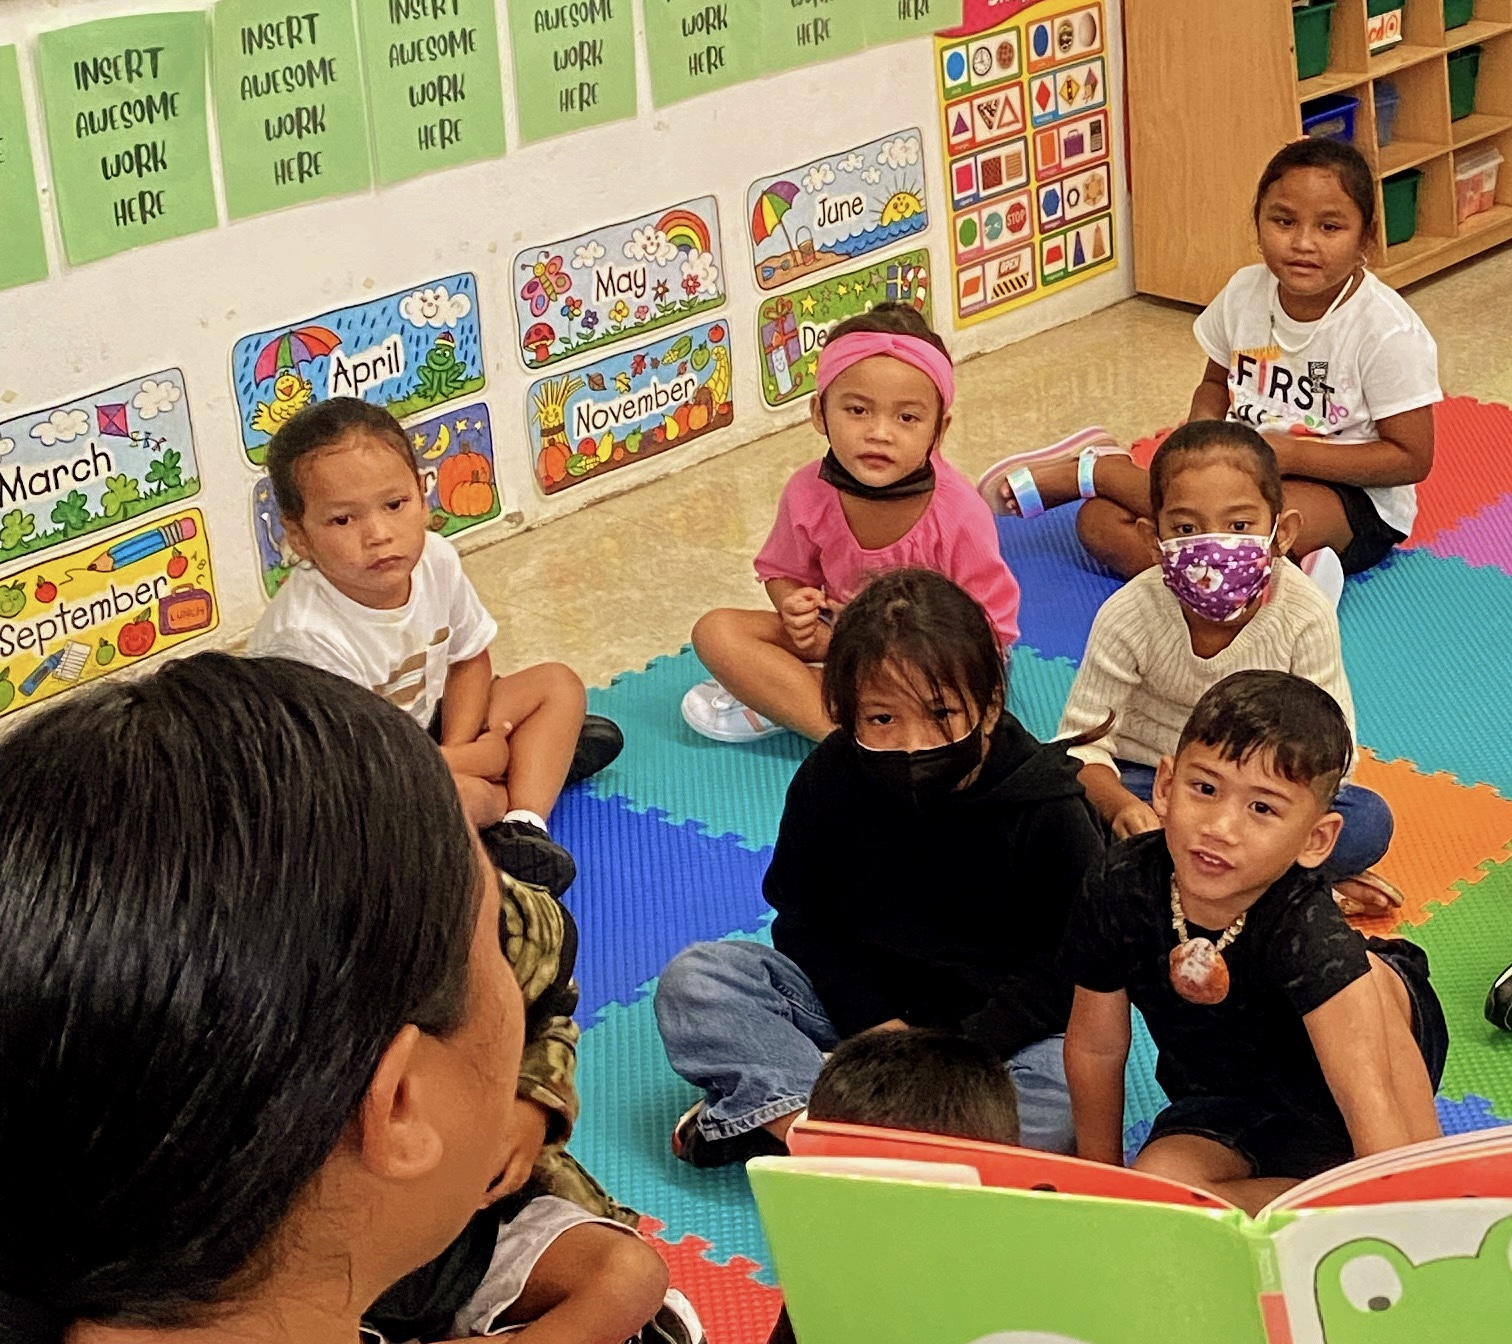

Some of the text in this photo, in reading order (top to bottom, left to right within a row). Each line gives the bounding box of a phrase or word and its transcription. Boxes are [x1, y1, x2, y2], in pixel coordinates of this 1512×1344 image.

[241, 13, 320, 55] INSERT
[681, 4, 728, 38] WORK
[796, 16, 832, 47] HERE
[388, 27, 478, 69] AWESOME
[554, 40, 603, 73] WORK
[688, 44, 726, 77] HERE
[74, 47, 165, 91] INSERT
[240, 57, 337, 101] AWESOME
[409, 73, 465, 108] WORK
[559, 81, 599, 113] HERE
[75, 91, 180, 139] AWESOME
[265, 104, 325, 142] WORK
[418, 118, 463, 151] HERE
[101, 140, 167, 181] WORK
[274, 151, 323, 186] HERE
[113, 189, 166, 227] HERE
[818, 194, 864, 230] June
[1007, 209, 1026, 227] STOP
[595, 265, 648, 302] May
[332, 342, 402, 394] April
[1237, 353, 1335, 419] FIRST
[576, 379, 695, 437] November
[0, 443, 112, 508] March
[0, 575, 168, 656] September
